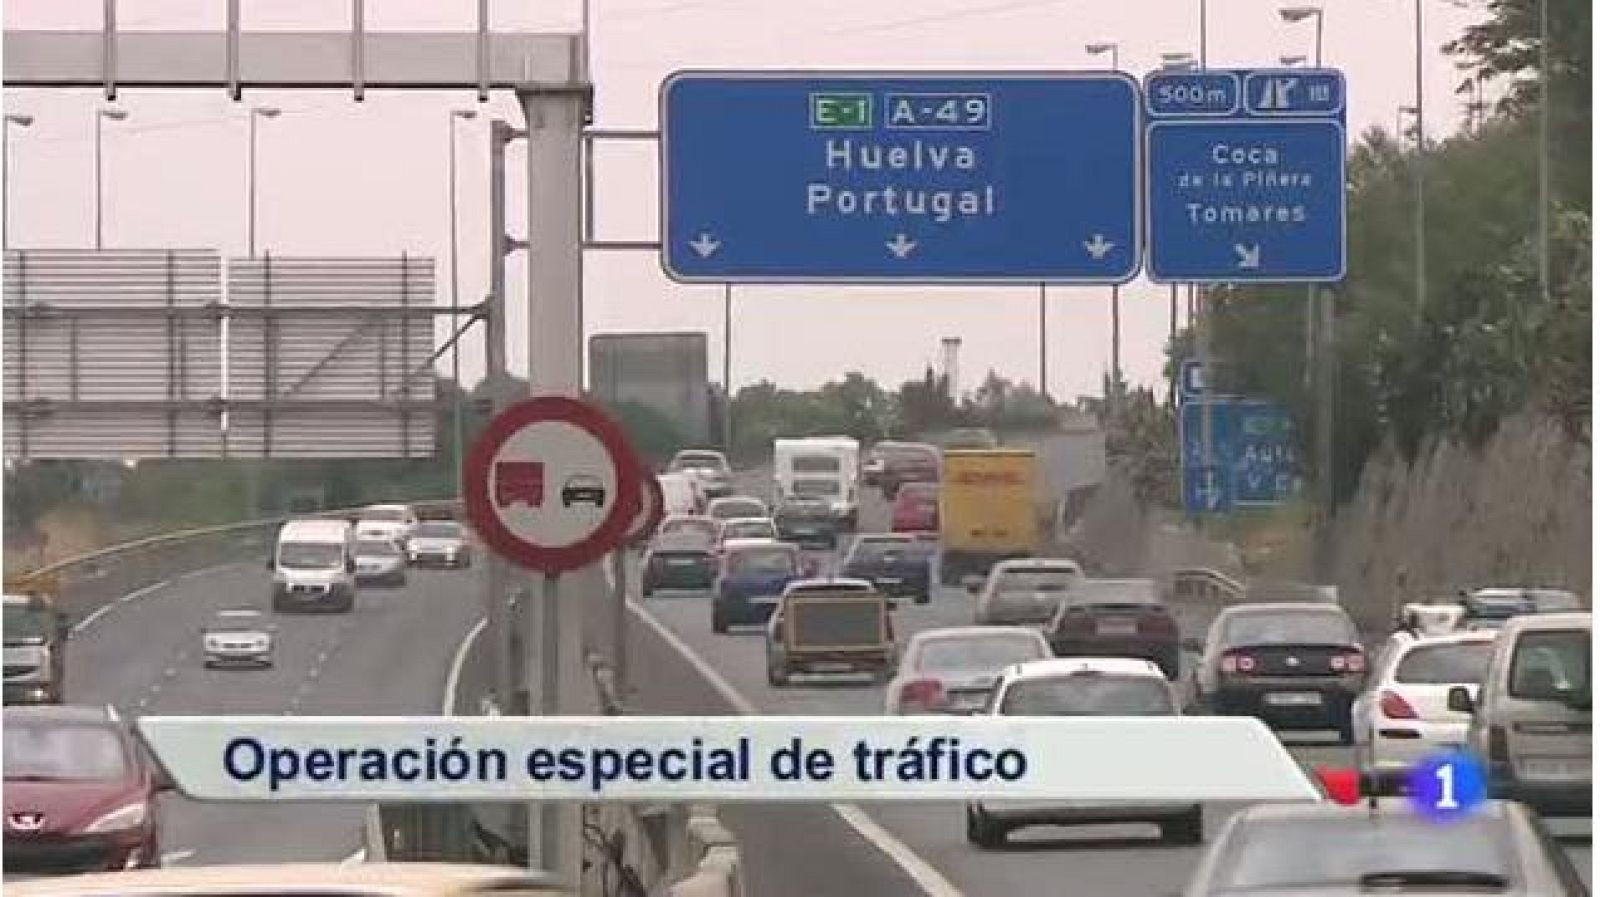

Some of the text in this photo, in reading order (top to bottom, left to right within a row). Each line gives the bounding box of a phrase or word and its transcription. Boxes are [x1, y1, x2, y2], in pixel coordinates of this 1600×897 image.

[815, 99, 868, 123] E-1
[891, 98, 987, 123] A-49
[825, 139, 976, 169] Huelva
[807, 184, 994, 221] Portugal
[1186, 202, 1306, 224] Tomares
